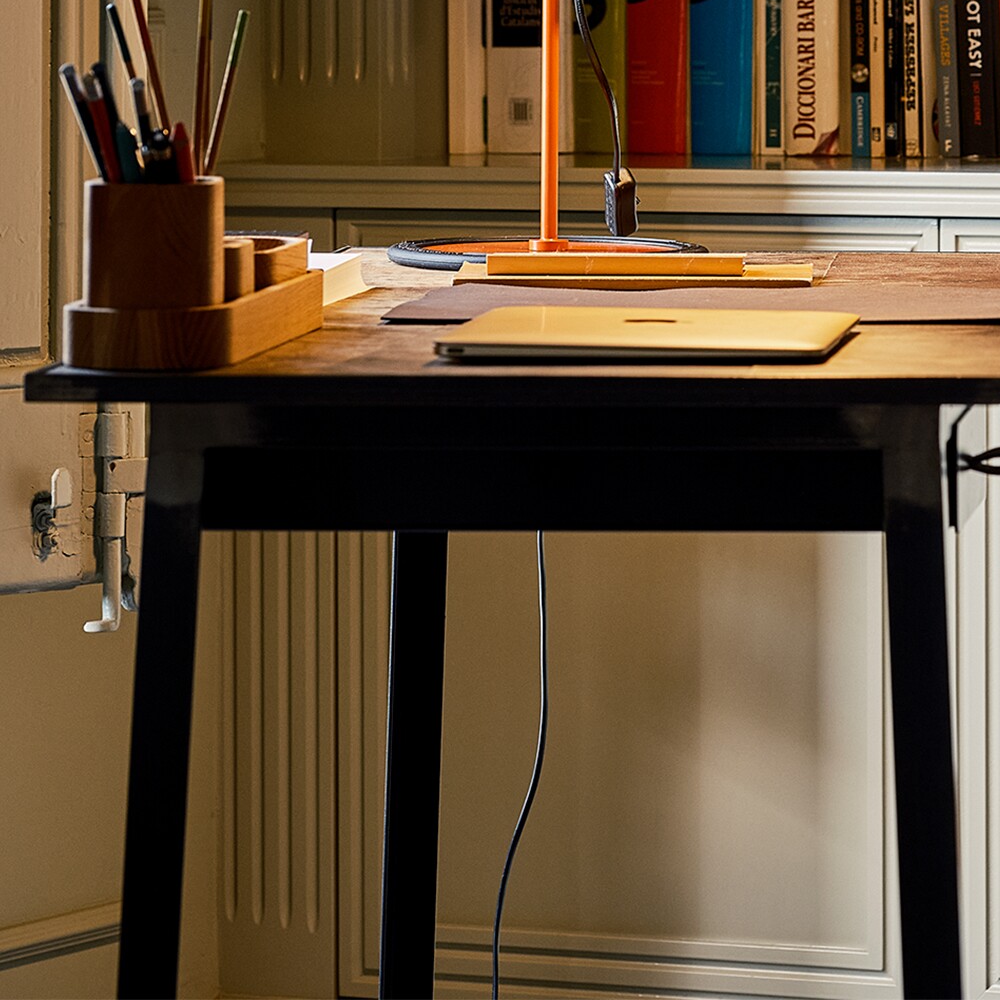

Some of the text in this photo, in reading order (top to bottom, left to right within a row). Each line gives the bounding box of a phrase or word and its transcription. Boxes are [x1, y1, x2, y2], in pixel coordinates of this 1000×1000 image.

[904, 22, 916, 111] REPASSEM
[938, 4, 951, 67] VILLAGES
[967, 28, 983, 69] EASY
[792, 35, 816, 140] DICCIONARI
[856, 95, 865, 147] CAMBRIDGE
